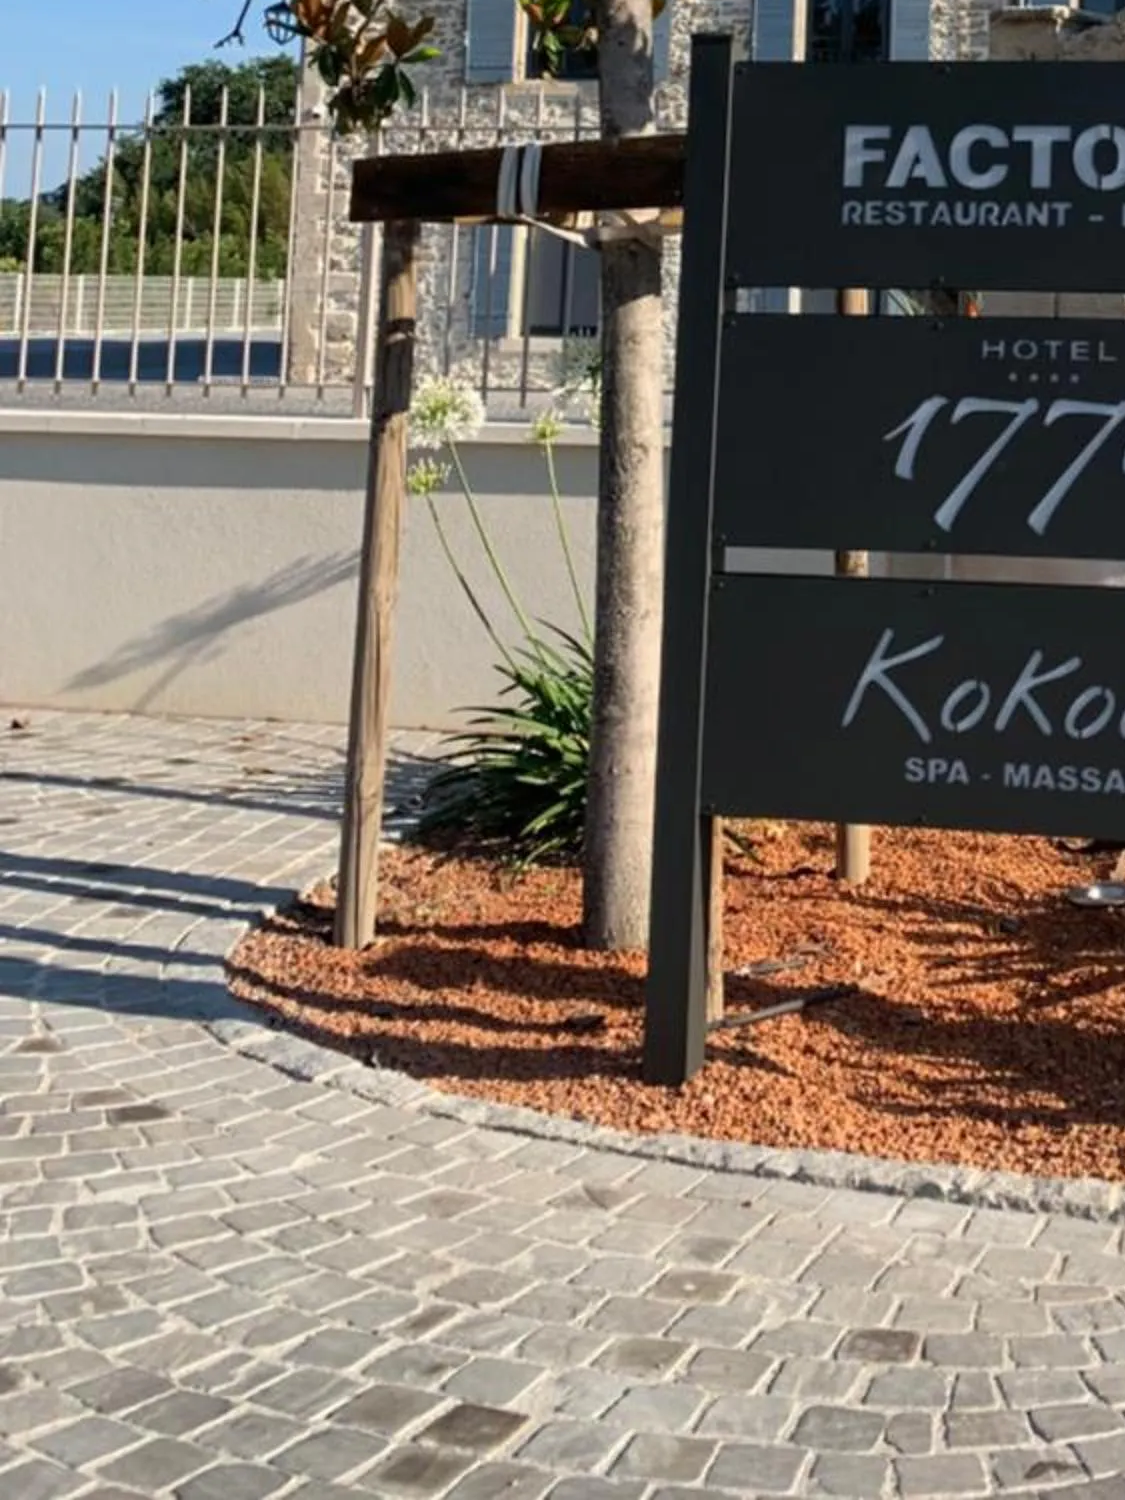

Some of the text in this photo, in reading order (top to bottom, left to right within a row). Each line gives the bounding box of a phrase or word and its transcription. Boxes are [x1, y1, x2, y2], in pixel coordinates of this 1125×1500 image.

[842, 200, 1072, 227] RESTAURANT
[982, 338, 1117, 362] HOTEL
[904, 757, 970, 786] SPA
